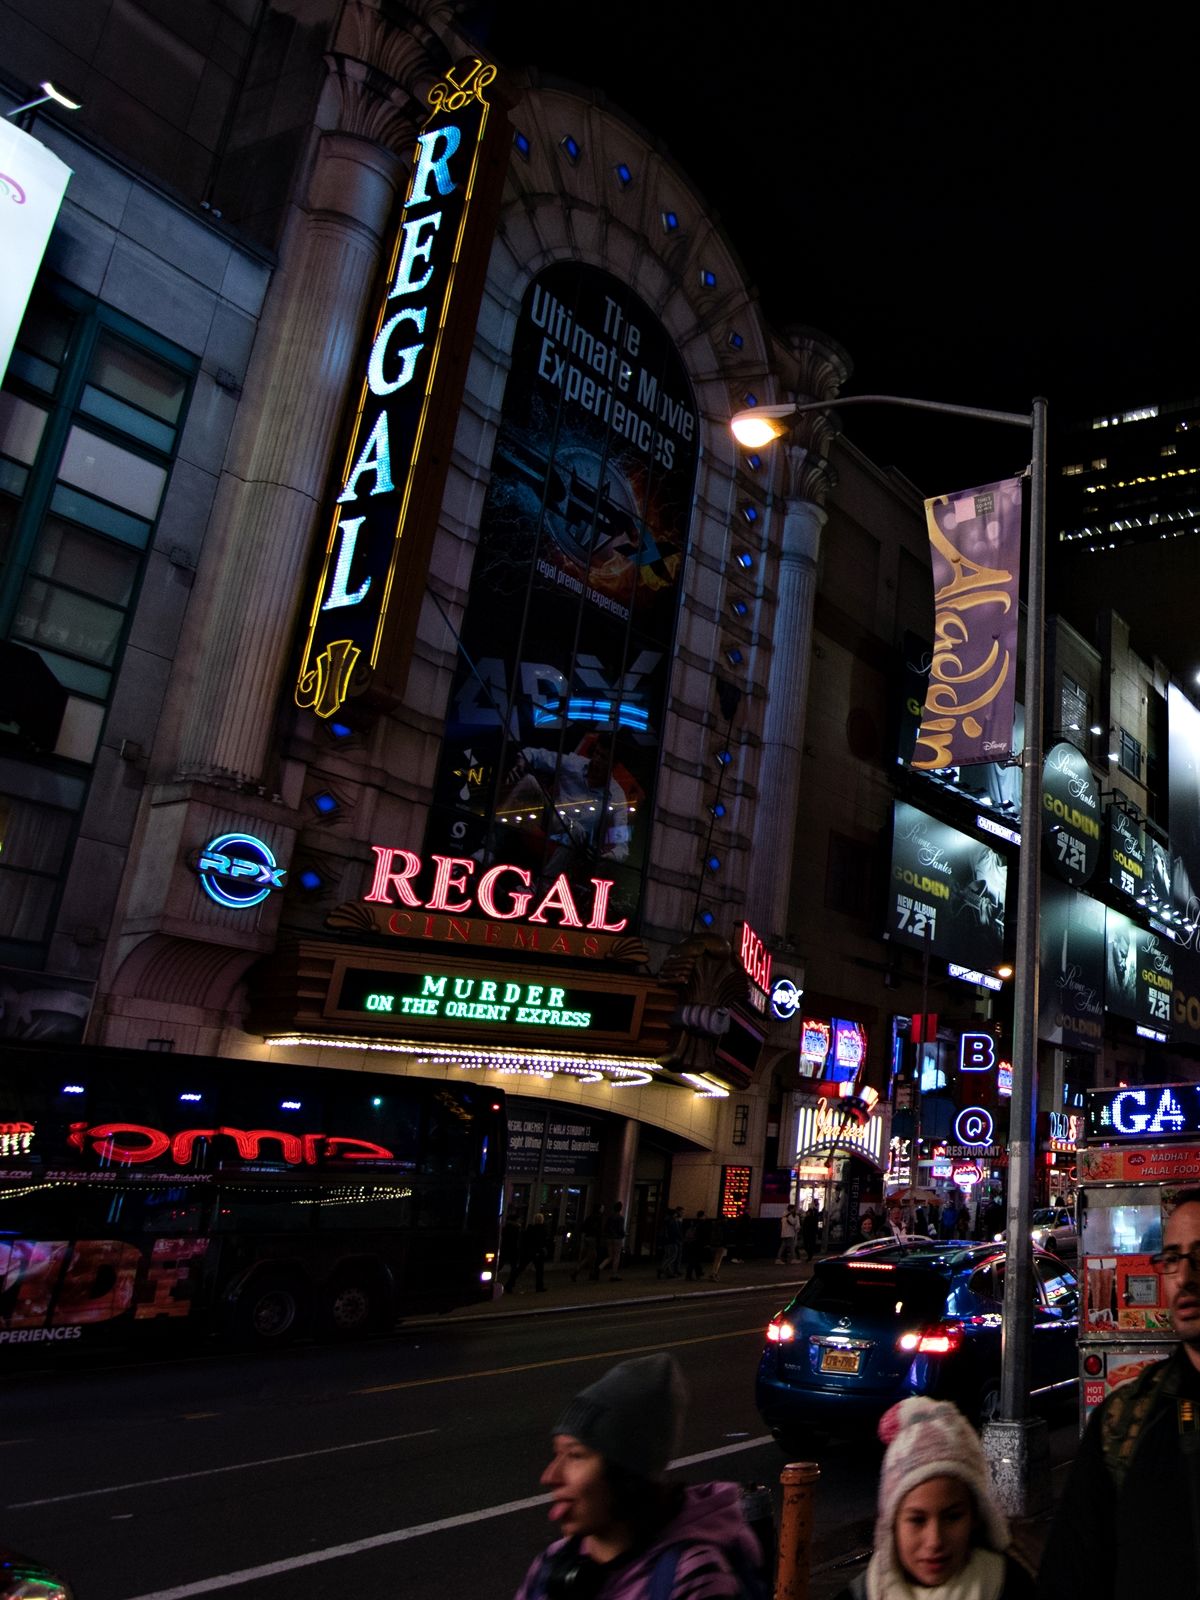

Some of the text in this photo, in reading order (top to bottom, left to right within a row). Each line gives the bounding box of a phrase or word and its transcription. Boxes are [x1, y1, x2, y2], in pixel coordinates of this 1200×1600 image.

[531, 284, 633, 392] Ultimate
[603, 295, 641, 357] The
[322, 125, 462, 610] REGAL
[535, 558, 557, 582] regal
[200, 851, 288, 888] RPX
[1057, 840, 1086, 874] 7.21
[364, 845, 629, 933] REGAL
[897, 893, 912, 910] NEW
[387, 911, 600, 957] CINEMAS
[896, 907, 938, 941] 7.21
[741, 921, 772, 996] REGAL
[421, 974, 567, 1008] MURDER
[1149, 995, 1171, 1021] 7.21
[366, 994, 592, 1028] ON THE ORIENT EXPRESS
[946, 1145, 1000, 1158] RESTAURANT
[1151, 1152, 1190, 1162] MADHAT
[1141, 1165, 1200, 1175] HALAL FOOD
[1086, 1395, 1104, 1403] DOG
[1087, 1386, 1103, 1394] HOT
